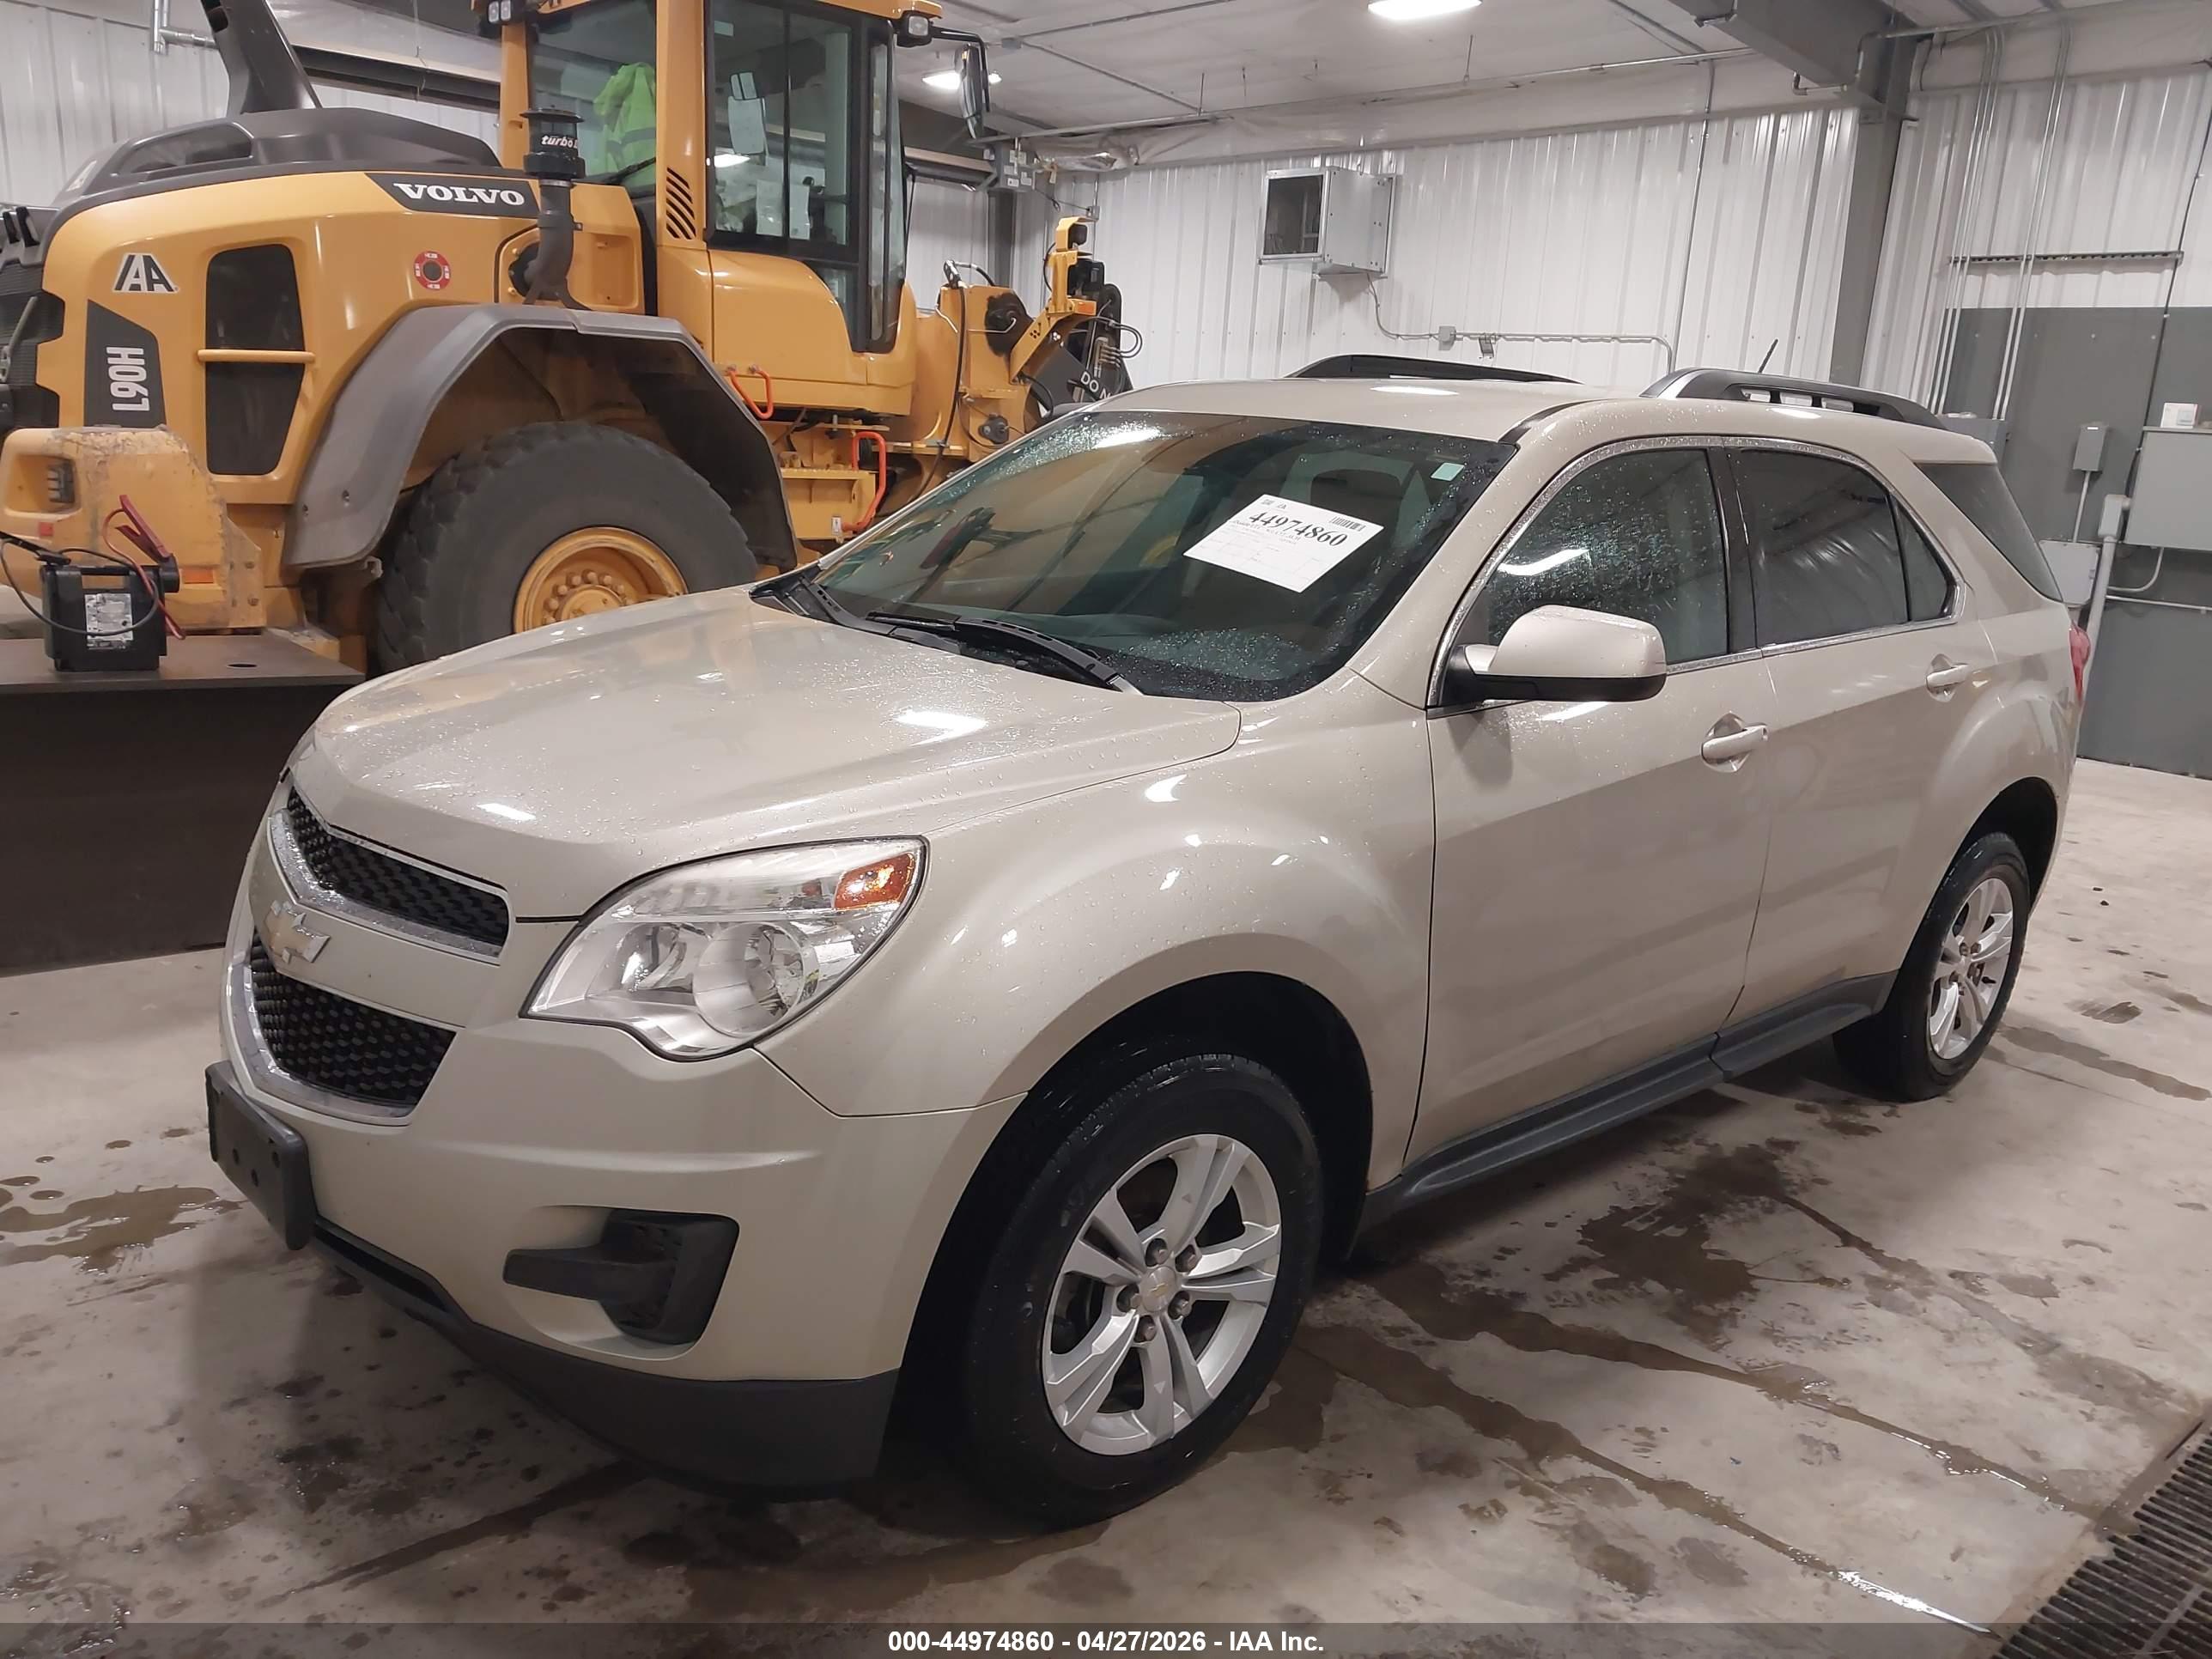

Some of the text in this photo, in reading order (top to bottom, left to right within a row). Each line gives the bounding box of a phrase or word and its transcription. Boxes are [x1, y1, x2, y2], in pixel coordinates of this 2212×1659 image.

[541, 135, 573, 149] turbo
[393, 183, 525, 206] VOLVO
[106, 347, 149, 411] L90H
[1080, 371, 1099, 392] DO
[1248, 511, 1347, 547] 44974860
